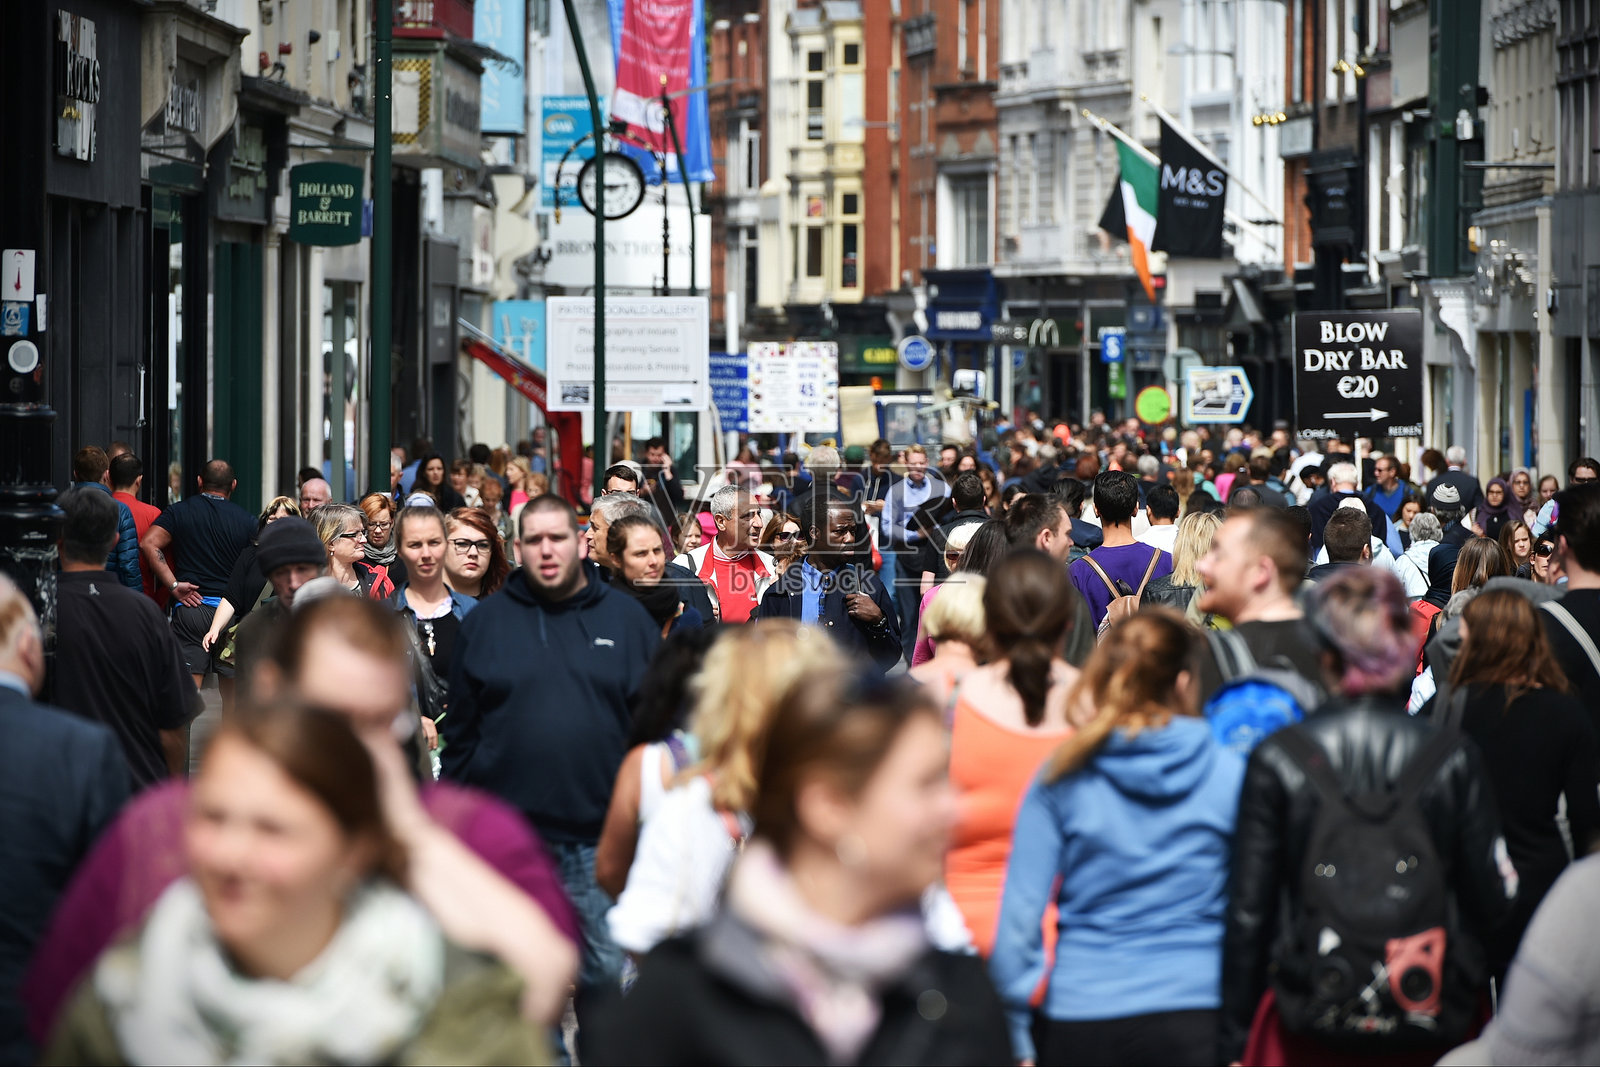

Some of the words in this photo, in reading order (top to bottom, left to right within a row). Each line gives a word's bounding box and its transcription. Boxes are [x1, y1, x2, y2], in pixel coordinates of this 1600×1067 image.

[298, 182, 354, 199] HOLLAND
[1161, 163, 1225, 196] M&S
[319, 196, 331, 210] &
[298, 209, 352, 226] BARRETT
[1320, 320, 1389, 343] BLOW
[1303, 348, 1354, 372] DRY
[1360, 347, 1408, 370] BAR
[1337, 375, 1379, 398] €20
